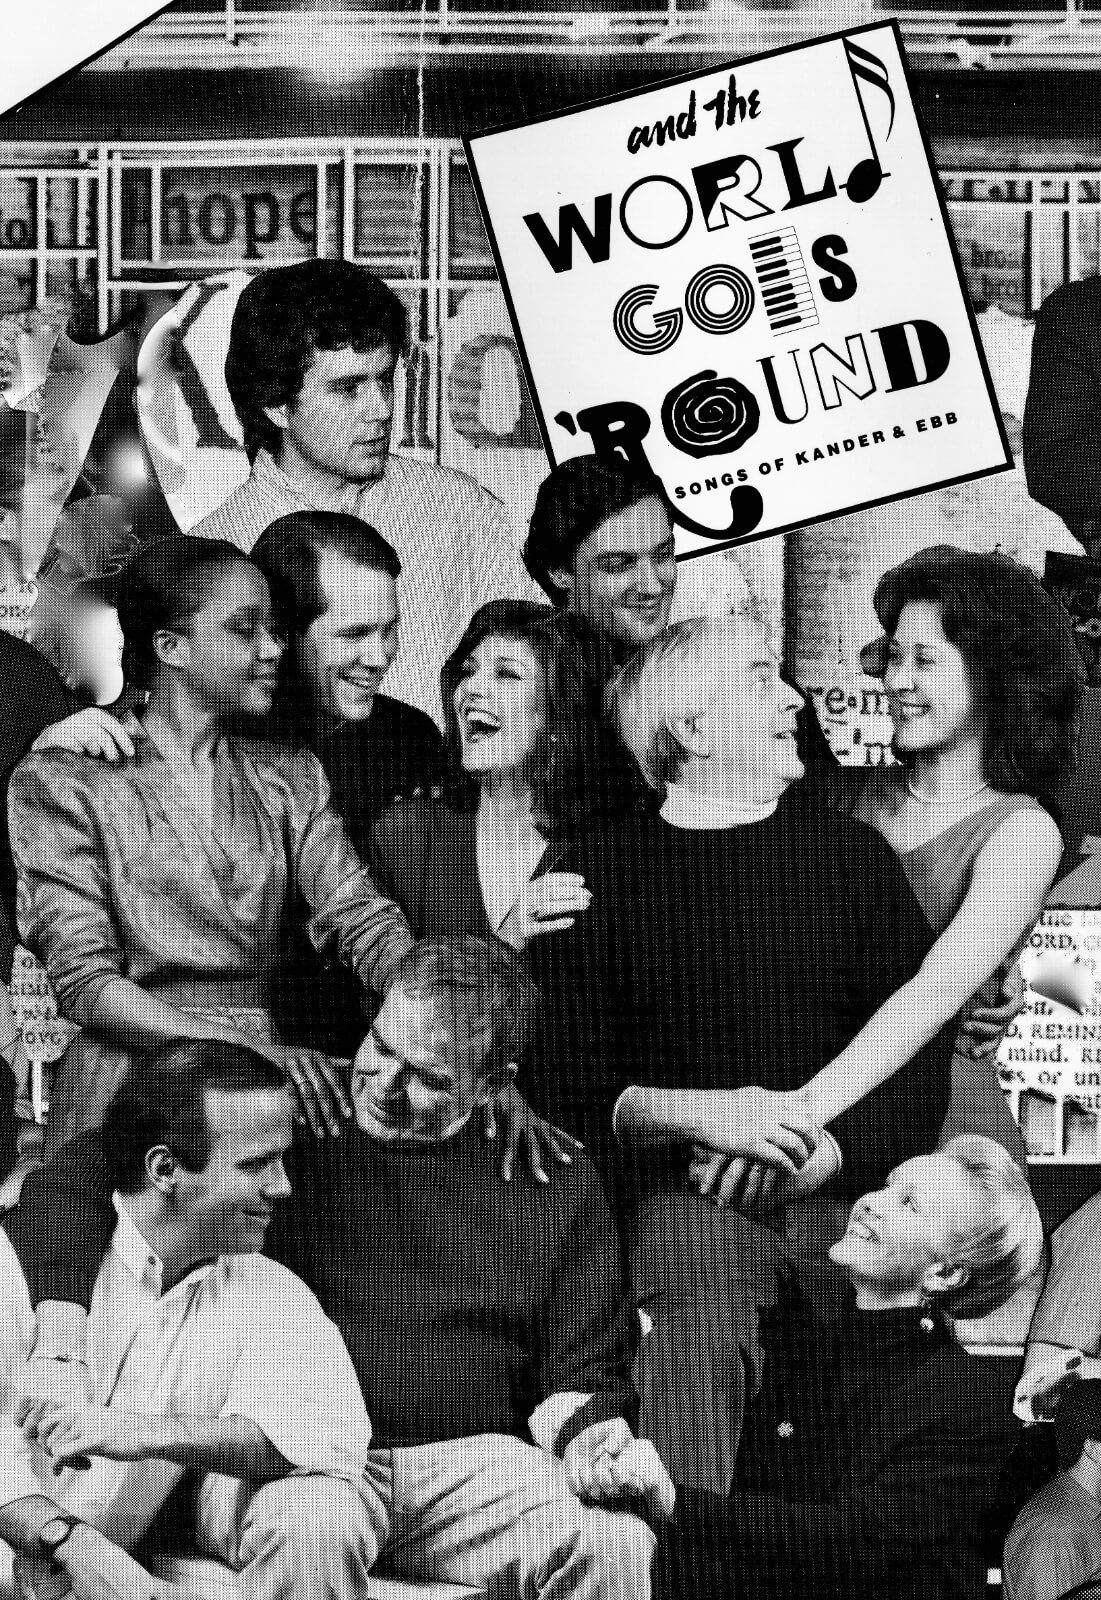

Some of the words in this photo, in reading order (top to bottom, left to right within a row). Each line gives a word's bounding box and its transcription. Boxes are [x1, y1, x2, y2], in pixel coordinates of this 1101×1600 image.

[627, 90, 697, 154] and
[703, 75, 762, 129] the
[161, 176, 317, 259] hope
[674, 468, 749, 500] SONGS
[758, 457, 786, 477] OF
[796, 431, 887, 464] KANDER
[892, 425, 906, 439] &
[916, 411, 960, 435] EBB
[1007, 1041, 1069, 1062] mind.
[1038, 1069, 1062, 1085] or
